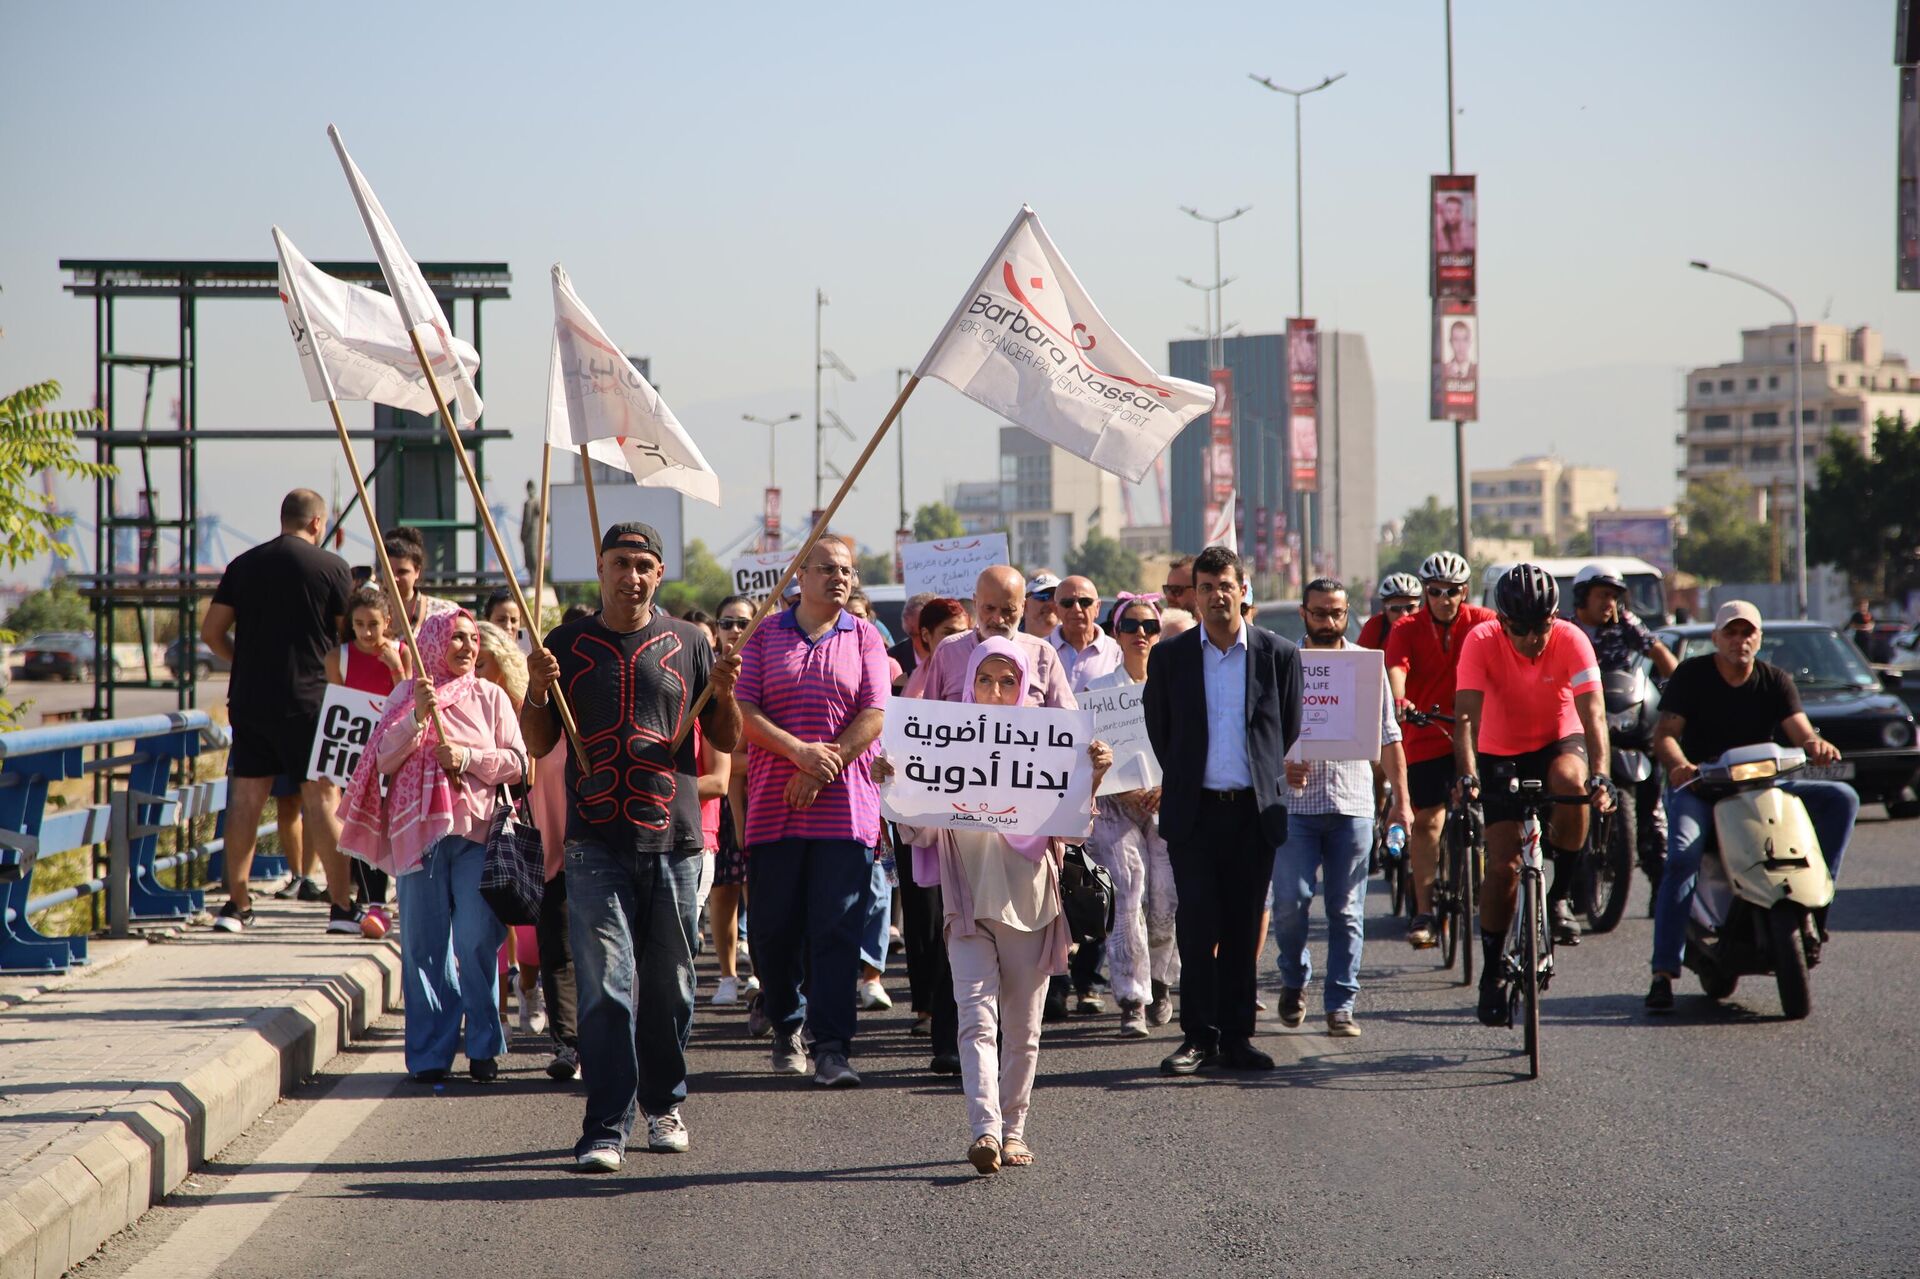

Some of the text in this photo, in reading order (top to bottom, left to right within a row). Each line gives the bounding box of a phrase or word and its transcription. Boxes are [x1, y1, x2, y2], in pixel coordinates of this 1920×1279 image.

[968, 294, 1164, 413] Barbara Nassar
[958, 319, 1150, 428] FOR CANCER PATIENT SUPPORT
[736, 568, 785, 592] Can
[1313, 682, 1329, 690] LIFE
[323, 704, 379, 746] Ca
[904, 714, 987, 748] أضوية
[994, 722, 1039, 752] بدنا
[1048, 724, 1074, 748] ما
[905, 751, 1069, 798] بدنا أدوية
